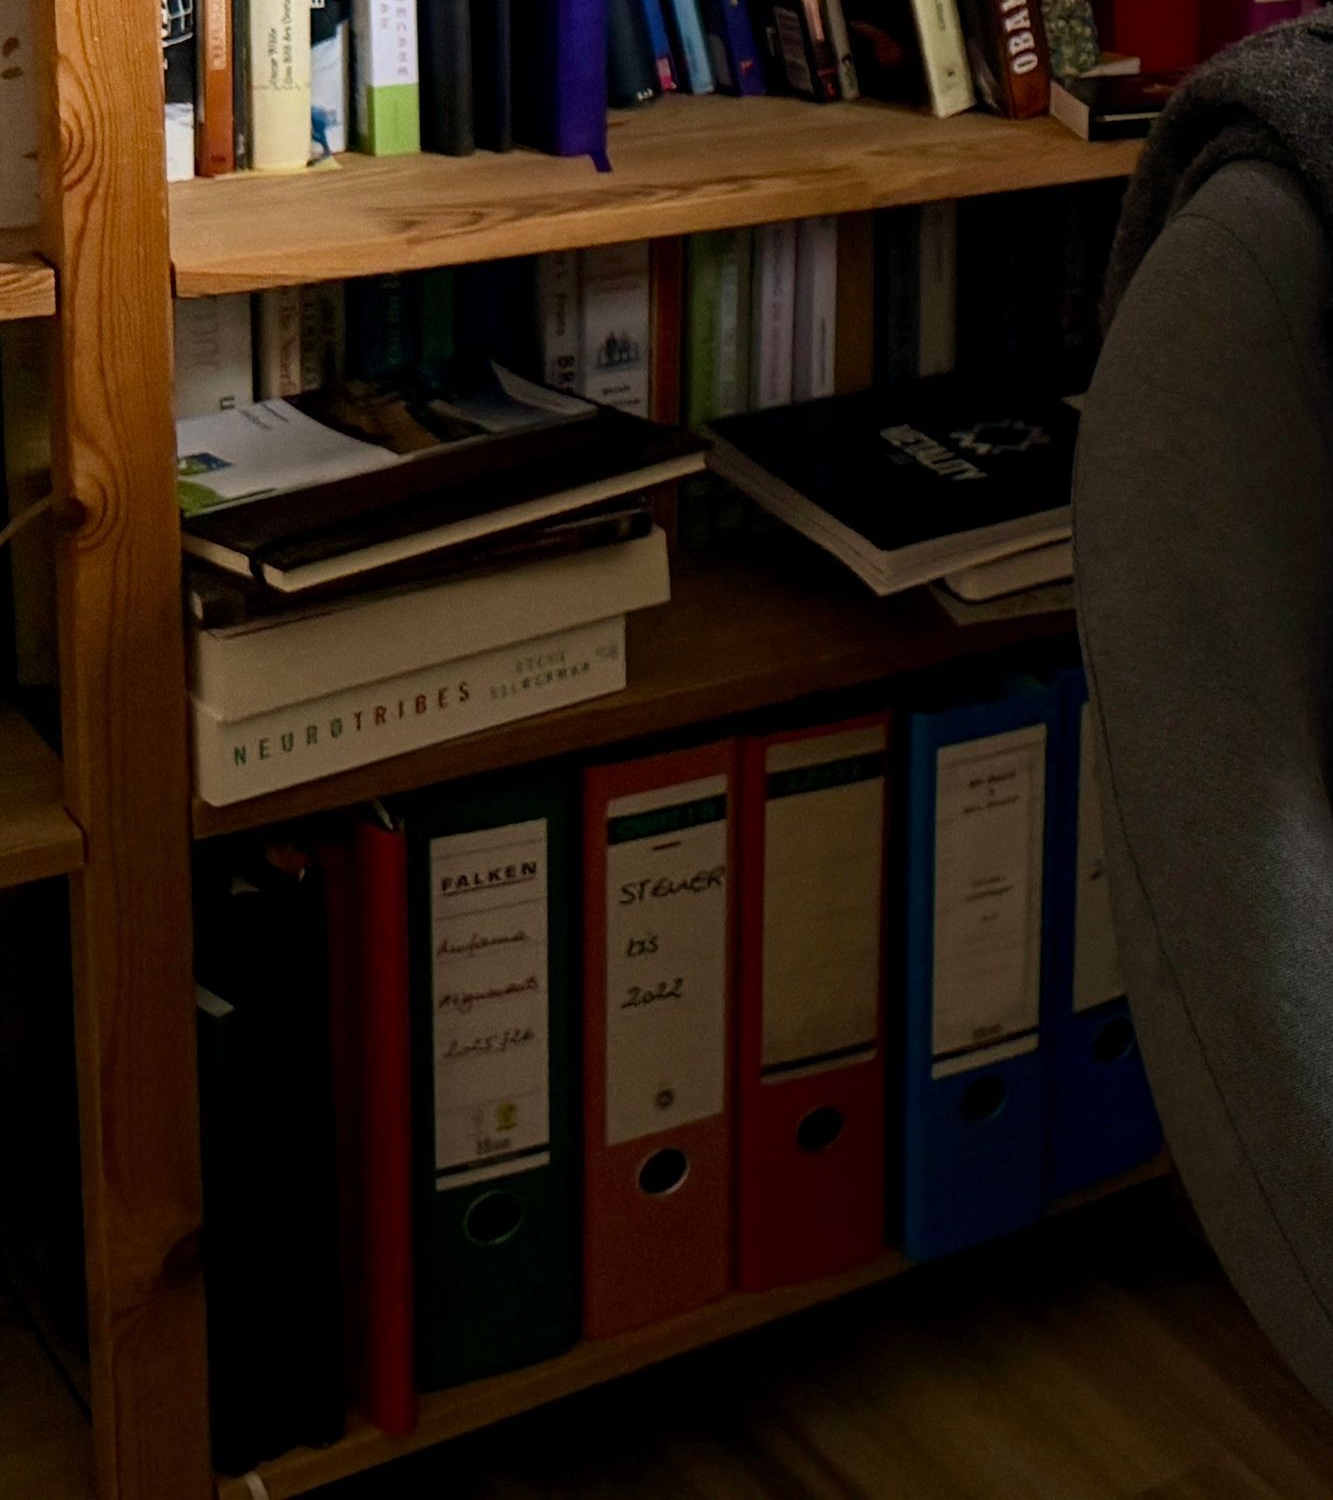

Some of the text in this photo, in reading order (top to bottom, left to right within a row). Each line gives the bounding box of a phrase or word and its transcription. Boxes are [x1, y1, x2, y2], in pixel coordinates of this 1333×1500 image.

[233, 681, 471, 767] NEUROTRIBES
[441, 861, 538, 892] FALKEN
[621, 978, 684, 1010] 2022
